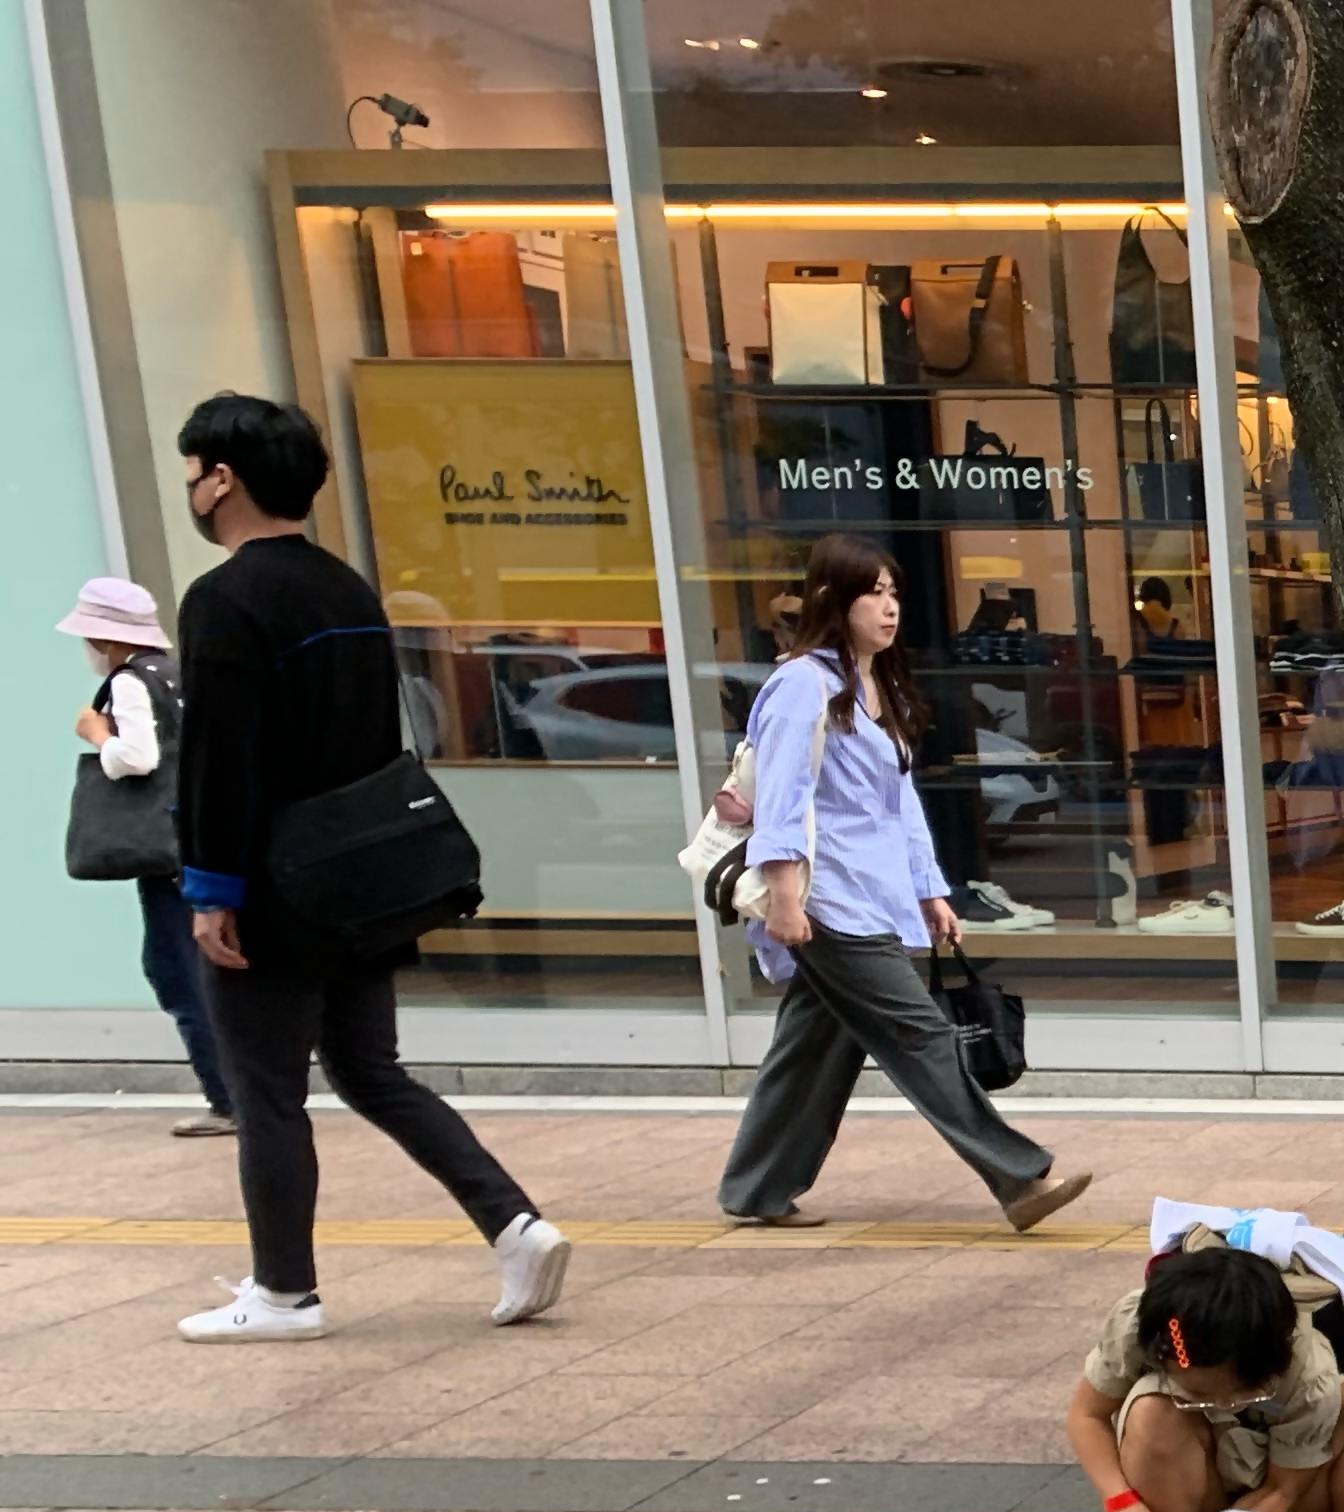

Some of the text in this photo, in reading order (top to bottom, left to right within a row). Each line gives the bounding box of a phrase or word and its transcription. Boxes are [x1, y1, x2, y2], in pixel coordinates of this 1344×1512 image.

[440, 464, 630, 504] Paul Smith
[778, 457, 1094, 491] Men's & Women's
[490, 513, 522, 525] AND
